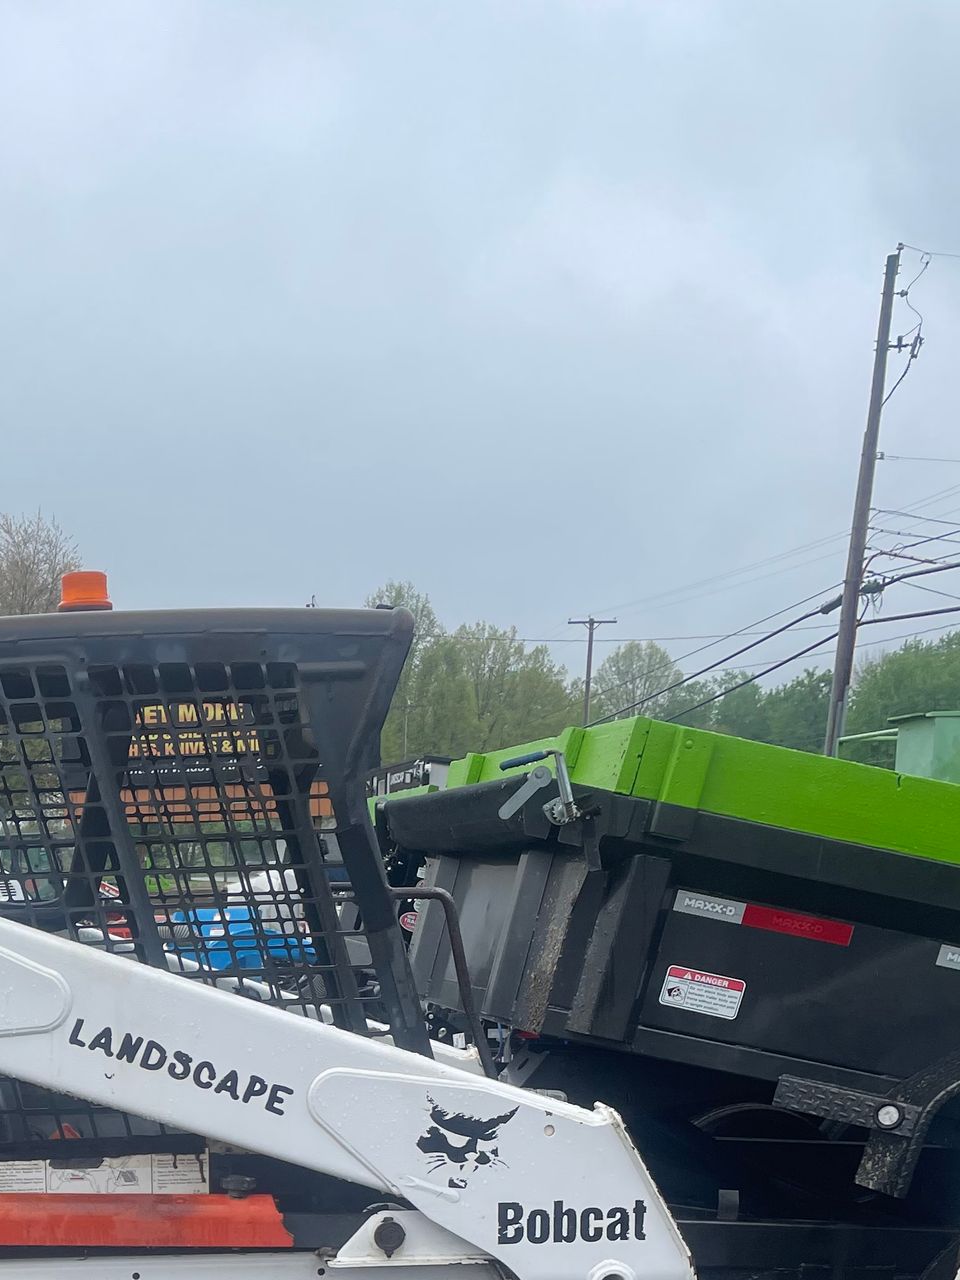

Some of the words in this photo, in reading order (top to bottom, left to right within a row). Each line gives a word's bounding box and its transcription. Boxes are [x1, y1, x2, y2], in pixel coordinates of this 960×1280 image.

[694, 973, 729, 988] DANGER
[68, 1017, 295, 1117] LANDSCAPE
[497, 1199, 648, 1245] Bobcat
